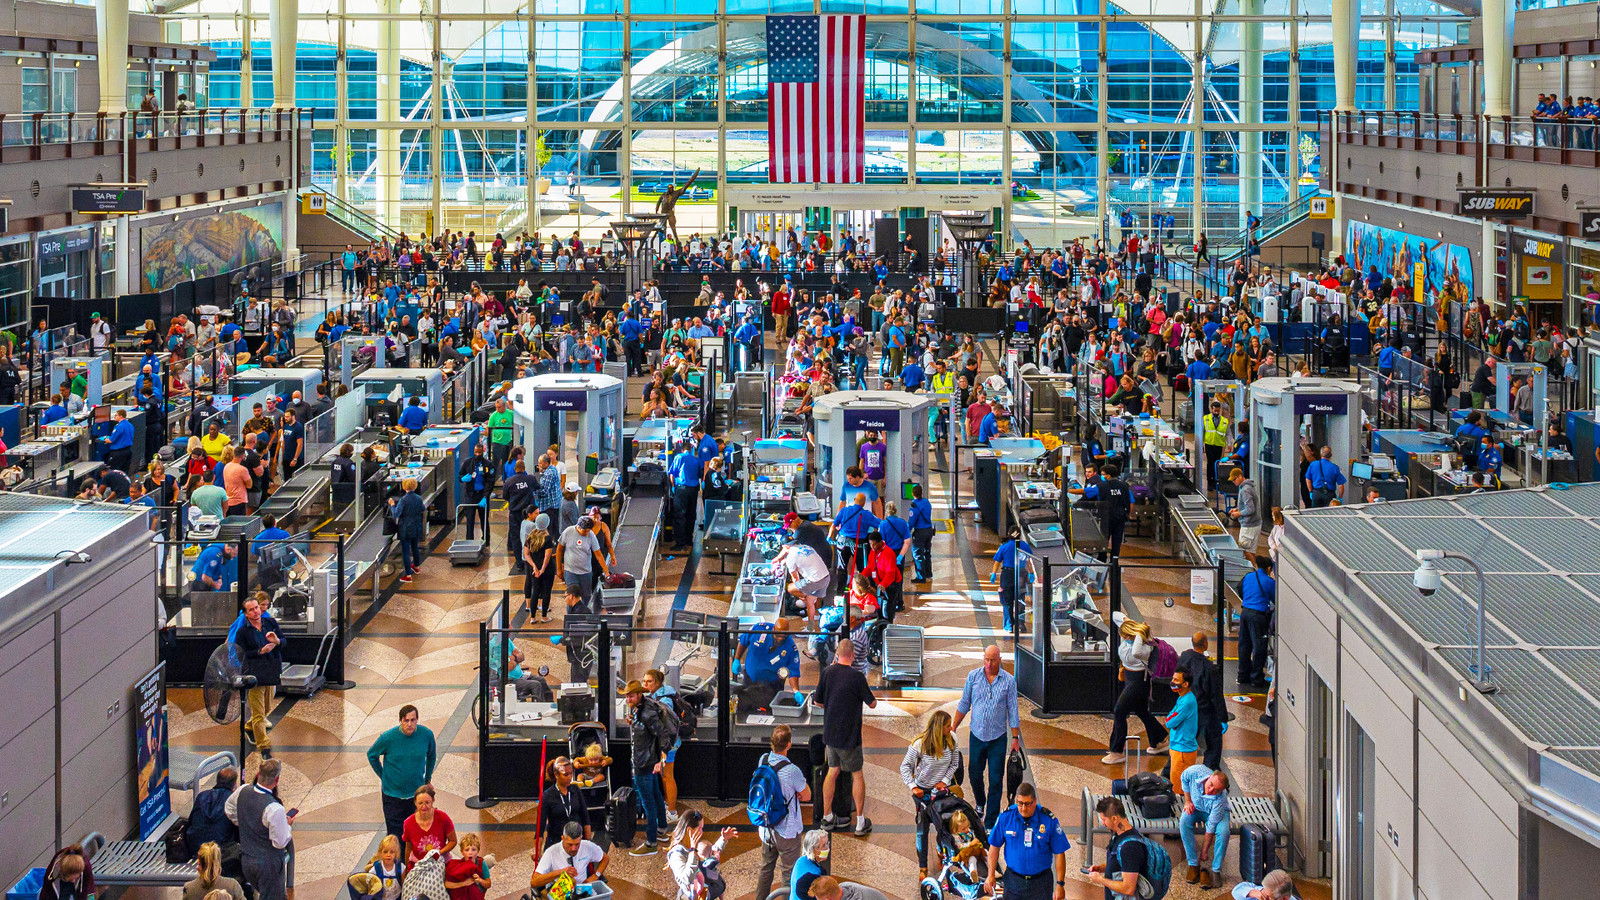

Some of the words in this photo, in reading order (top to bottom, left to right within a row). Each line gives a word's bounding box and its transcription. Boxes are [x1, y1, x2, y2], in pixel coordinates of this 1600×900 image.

[1464, 197, 1530, 210] SUBWAY
[42, 243, 51, 254] TSA
[1524, 239, 1554, 258] SUBWAY
[515, 482, 528, 490] TSA
